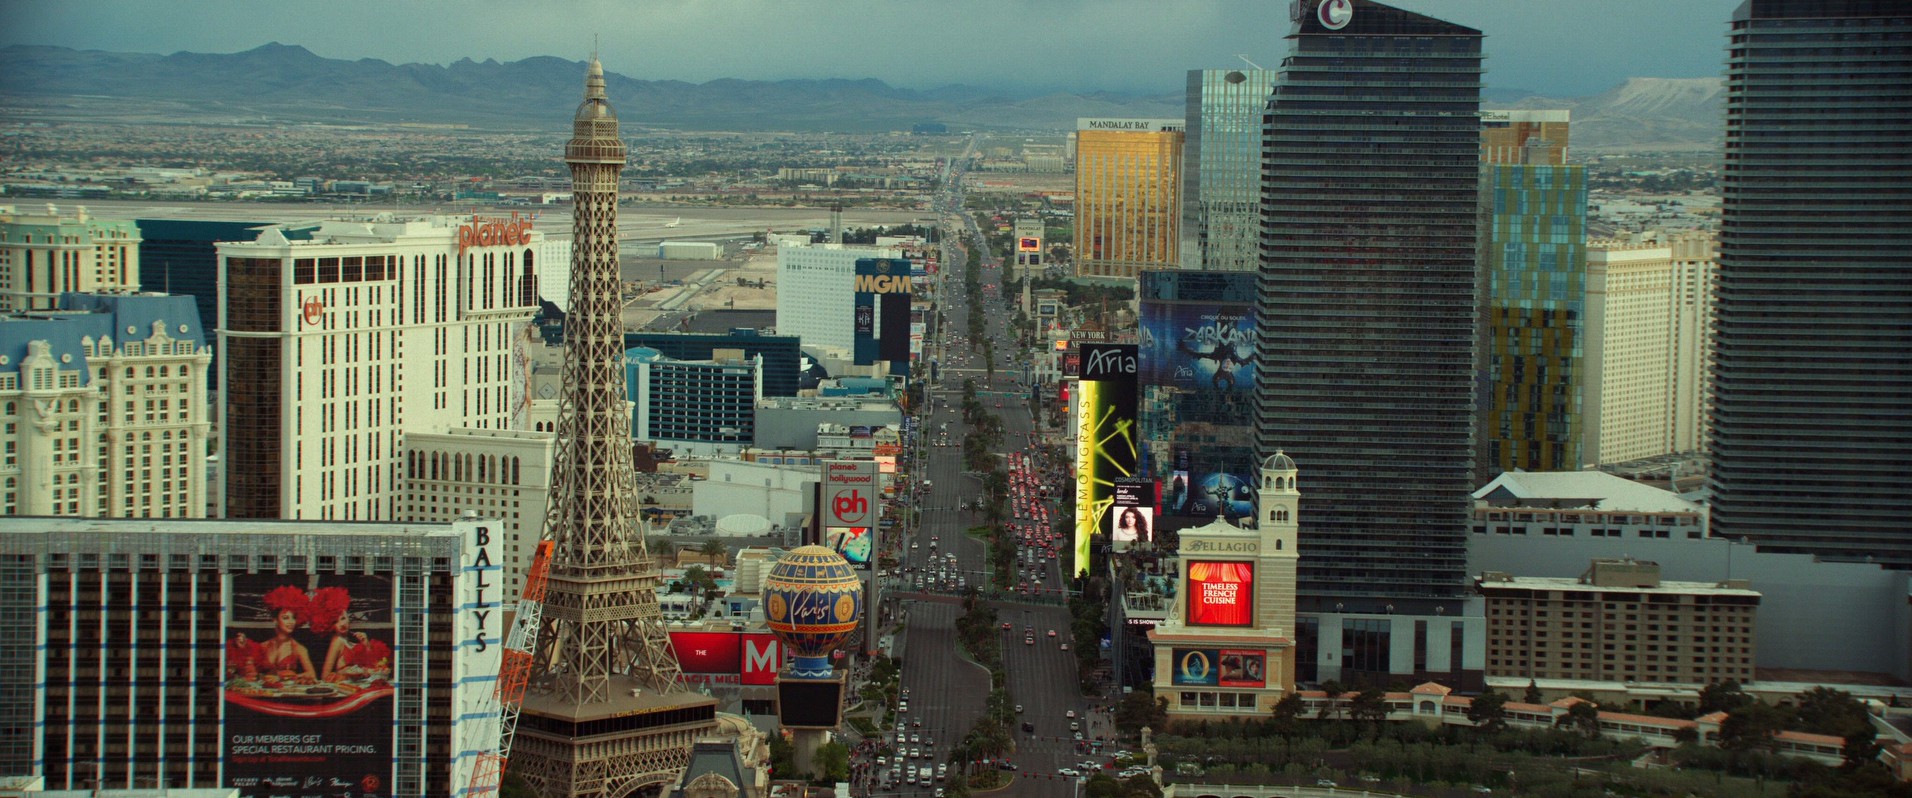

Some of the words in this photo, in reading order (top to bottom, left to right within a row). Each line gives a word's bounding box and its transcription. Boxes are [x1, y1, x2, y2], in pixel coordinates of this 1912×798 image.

[1090, 121, 1133, 129] MANDALAY
[459, 214, 533, 256] planet
[854, 274, 912, 294] MGM
[1071, 331, 1086, 339] NEW
[1087, 331, 1105, 339] YORK
[1086, 349, 1137, 376] Aria
[1174, 365, 1193, 378] Aria
[829, 463, 857, 471] planet
[1078, 400, 1090, 522] LEMONGRASS
[829, 475, 871, 484] hollywood
[834, 489, 868, 520] ph
[1185, 540, 1257, 552] BELLAGIO
[473, 526, 491, 653] BALLYS
[790, 585, 829, 631] Paris
[745, 639, 778, 673] M
[1181, 650, 1210, 681] O
[677, 674, 710, 684] RACLE
[715, 675, 739, 684] MILE
[232, 735, 253, 744] OUR
[255, 735, 300, 744] MEMBERS
[302, 735, 322, 744] GET
[232, 745, 269, 754] SPECIAL
[271, 745, 333, 754] RESTAURANT
[335, 745, 377, 754] PRICING.
